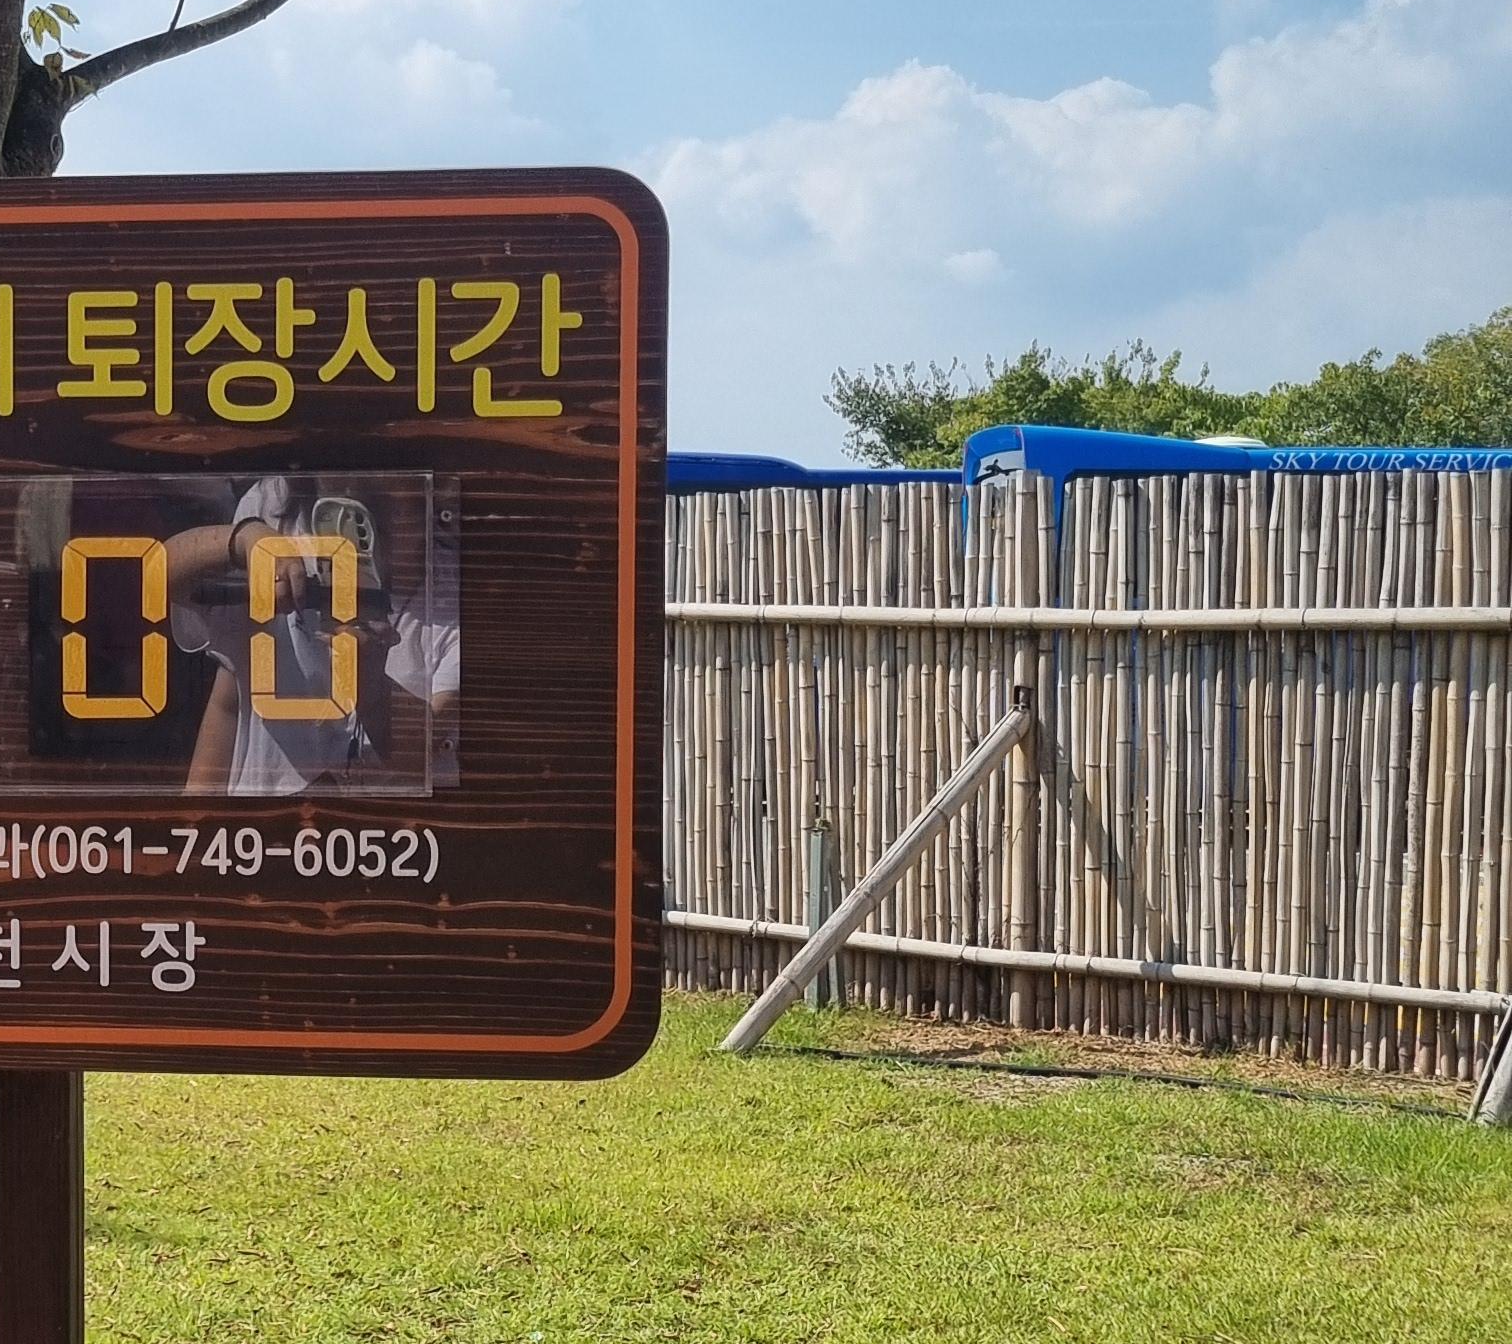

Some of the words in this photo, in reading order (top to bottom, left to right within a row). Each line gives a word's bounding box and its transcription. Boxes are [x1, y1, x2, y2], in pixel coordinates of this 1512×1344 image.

[57, 272, 583, 422] 퇴장시간
[1268, 452, 1327, 471] SKY
[1334, 452, 1407, 471] TOUR
